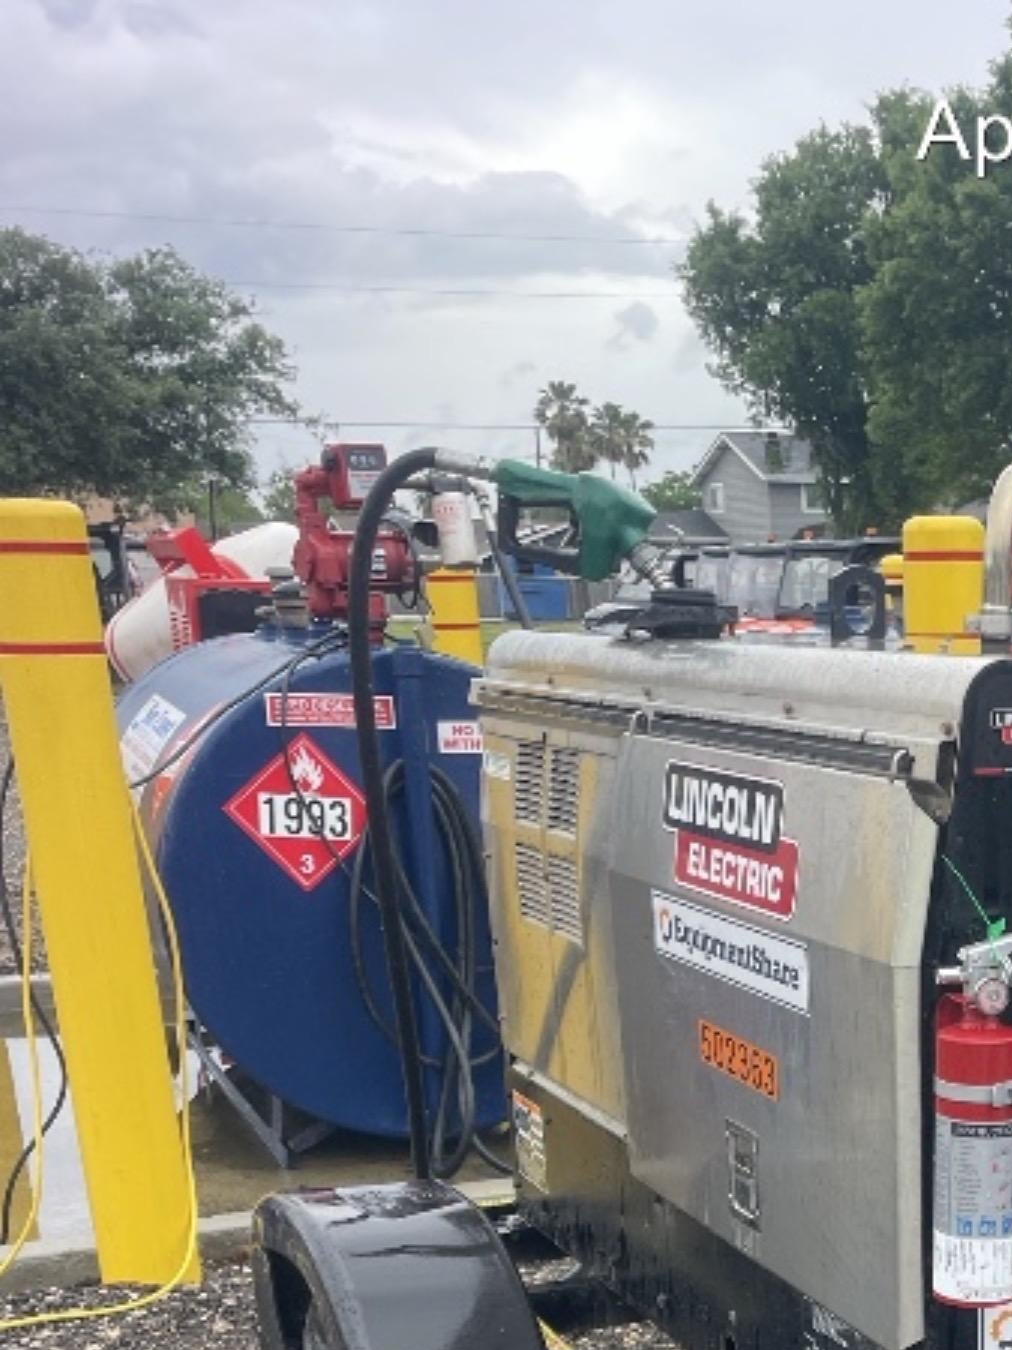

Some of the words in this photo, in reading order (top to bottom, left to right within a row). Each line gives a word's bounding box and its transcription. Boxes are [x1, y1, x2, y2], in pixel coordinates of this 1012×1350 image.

[262, 797, 349, 838] 1993
[668, 773, 776, 844] LINCOLN
[301, 853, 316, 874] 3
[686, 842, 784, 903] ELECTRIC
[673, 914, 800, 991] EquipmentShare
